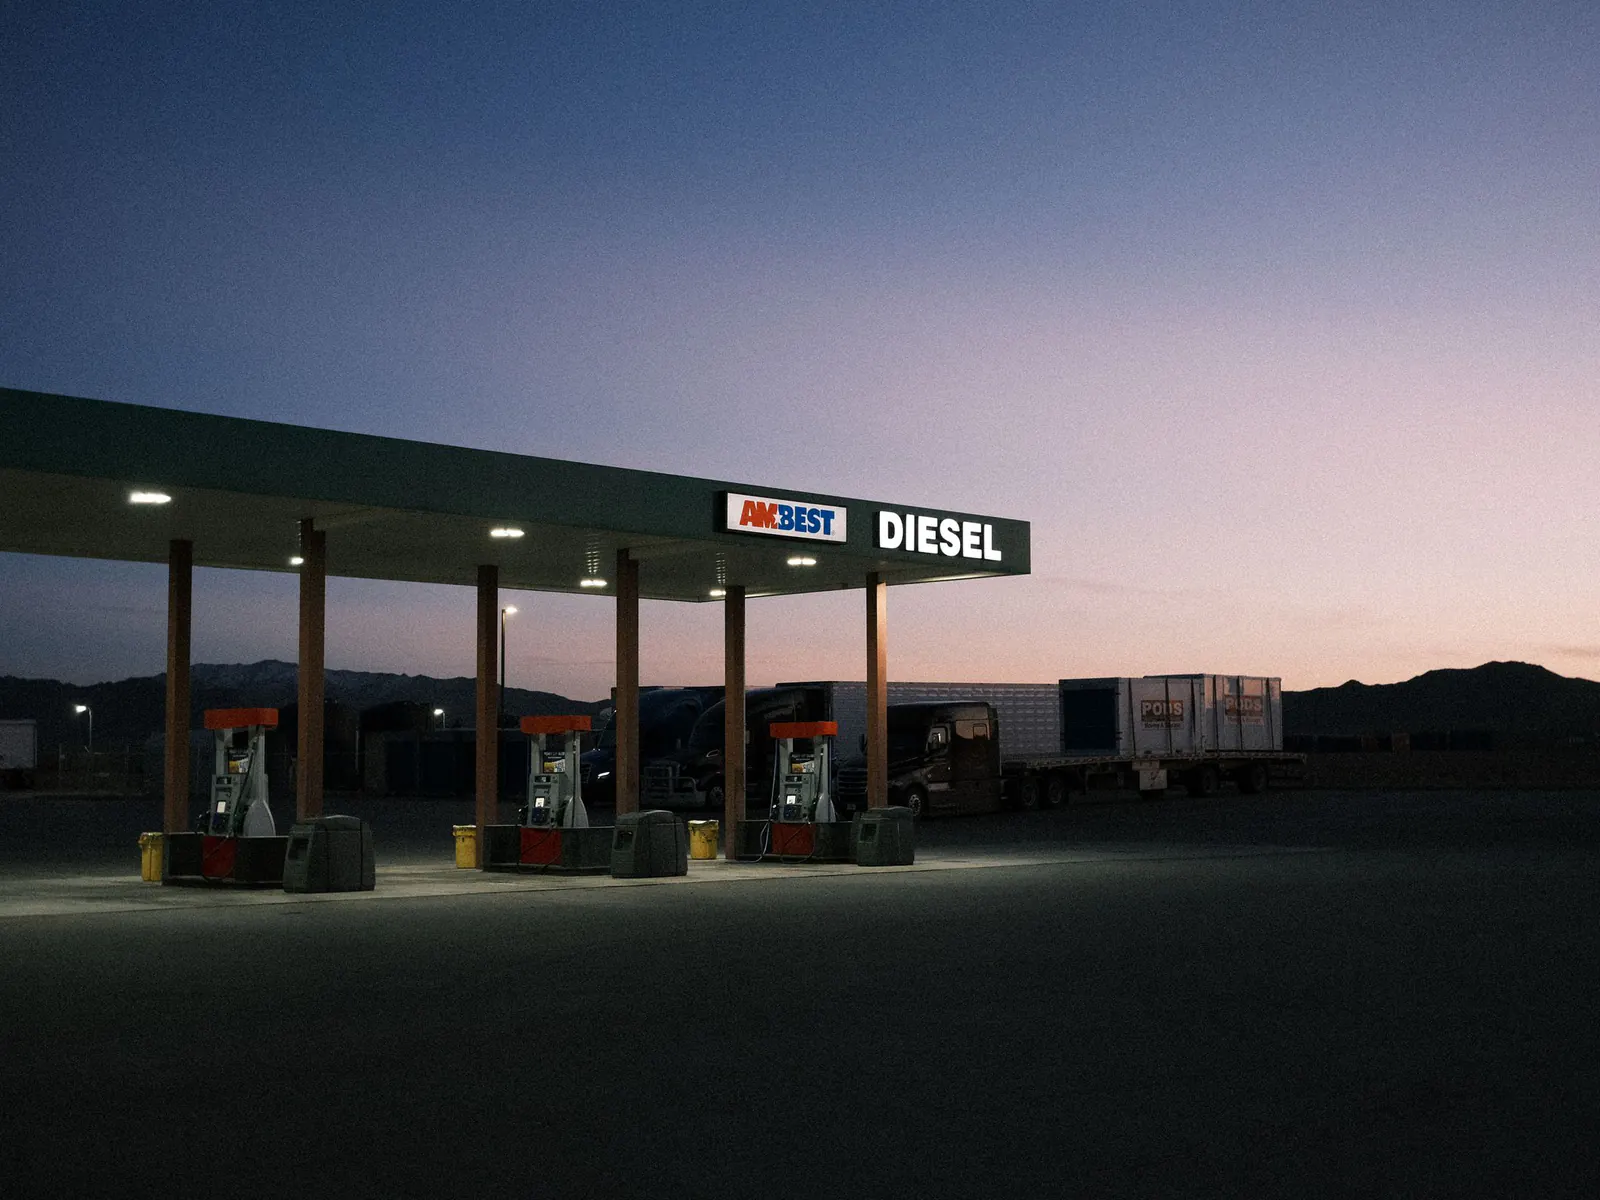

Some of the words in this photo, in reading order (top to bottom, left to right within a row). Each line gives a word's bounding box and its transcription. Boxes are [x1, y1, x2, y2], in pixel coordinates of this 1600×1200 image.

[739, 499, 835, 535] AMBEST
[878, 510, 1002, 562] DIESEL
[1142, 702, 1182, 716] PODS
